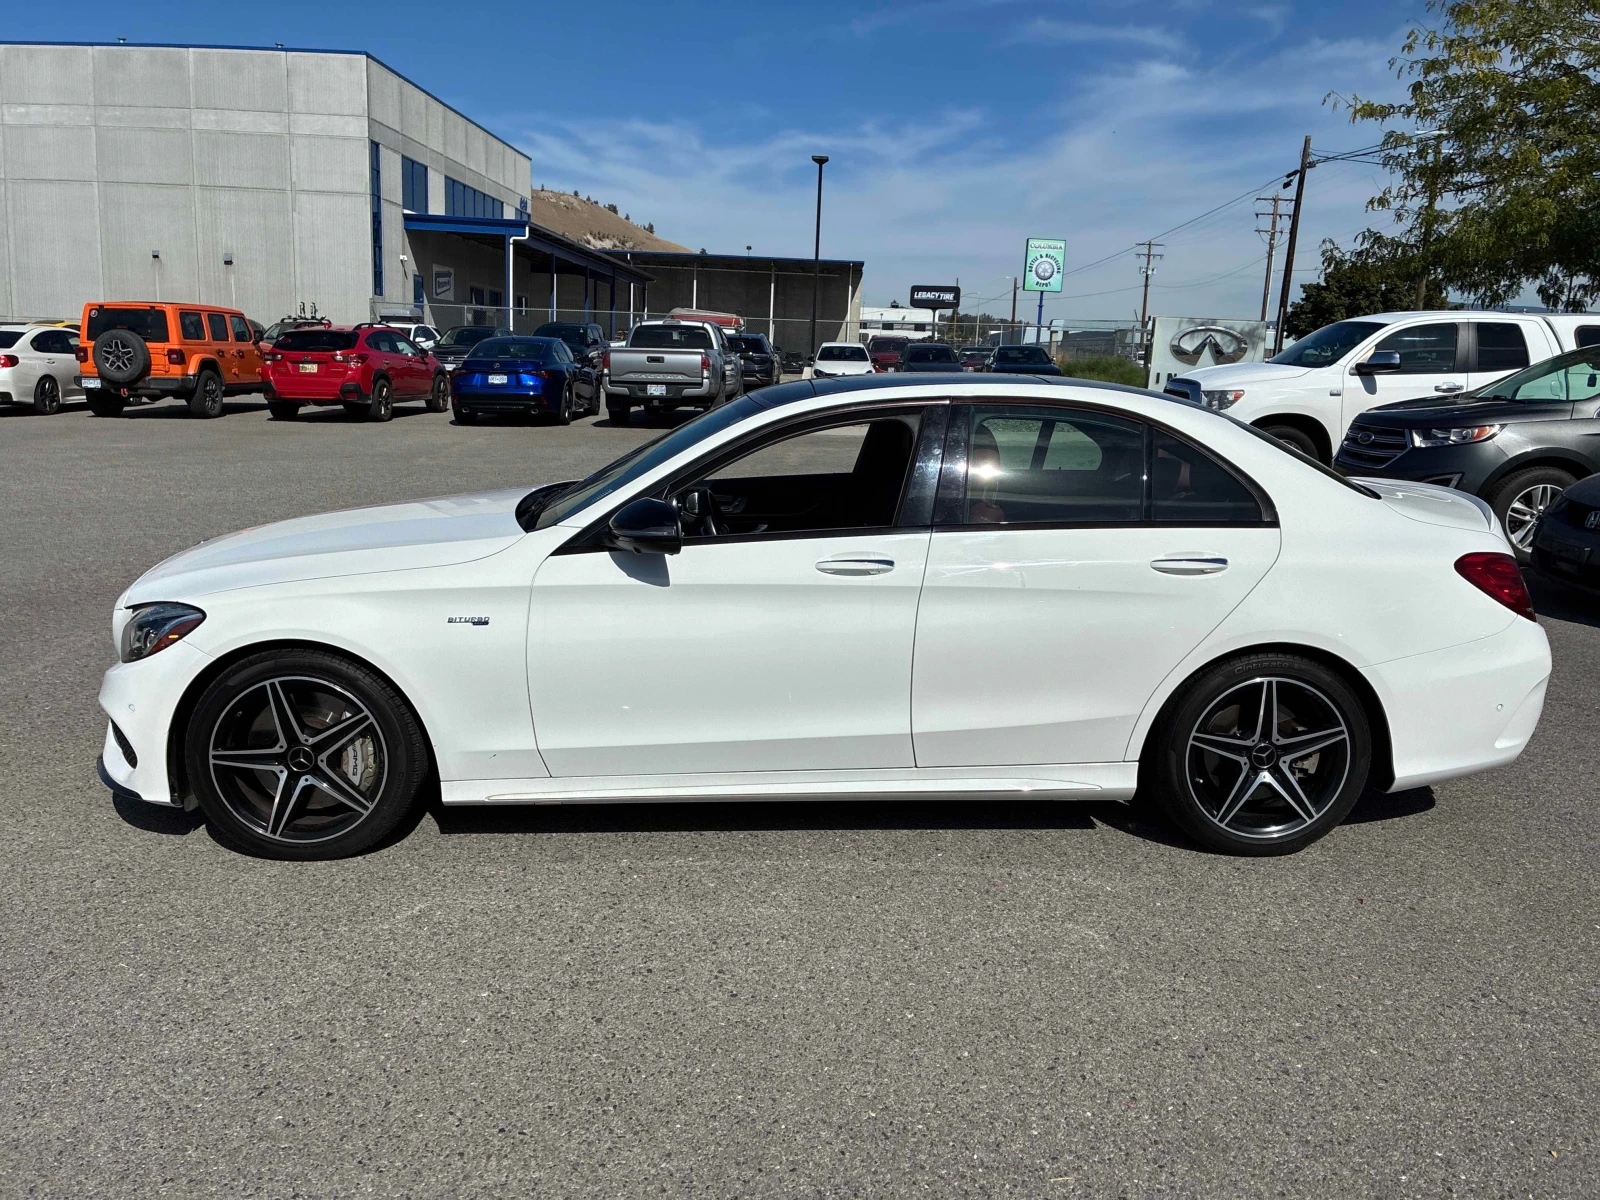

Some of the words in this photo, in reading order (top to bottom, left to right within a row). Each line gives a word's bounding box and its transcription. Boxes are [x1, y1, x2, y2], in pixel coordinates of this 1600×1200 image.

[1030, 242, 1063, 250] COLUMBIA
[1028, 256, 1039, 273] BOTTLE
[914, 291, 940, 299] LEGACY
[447, 616, 491, 624] BITURBO
